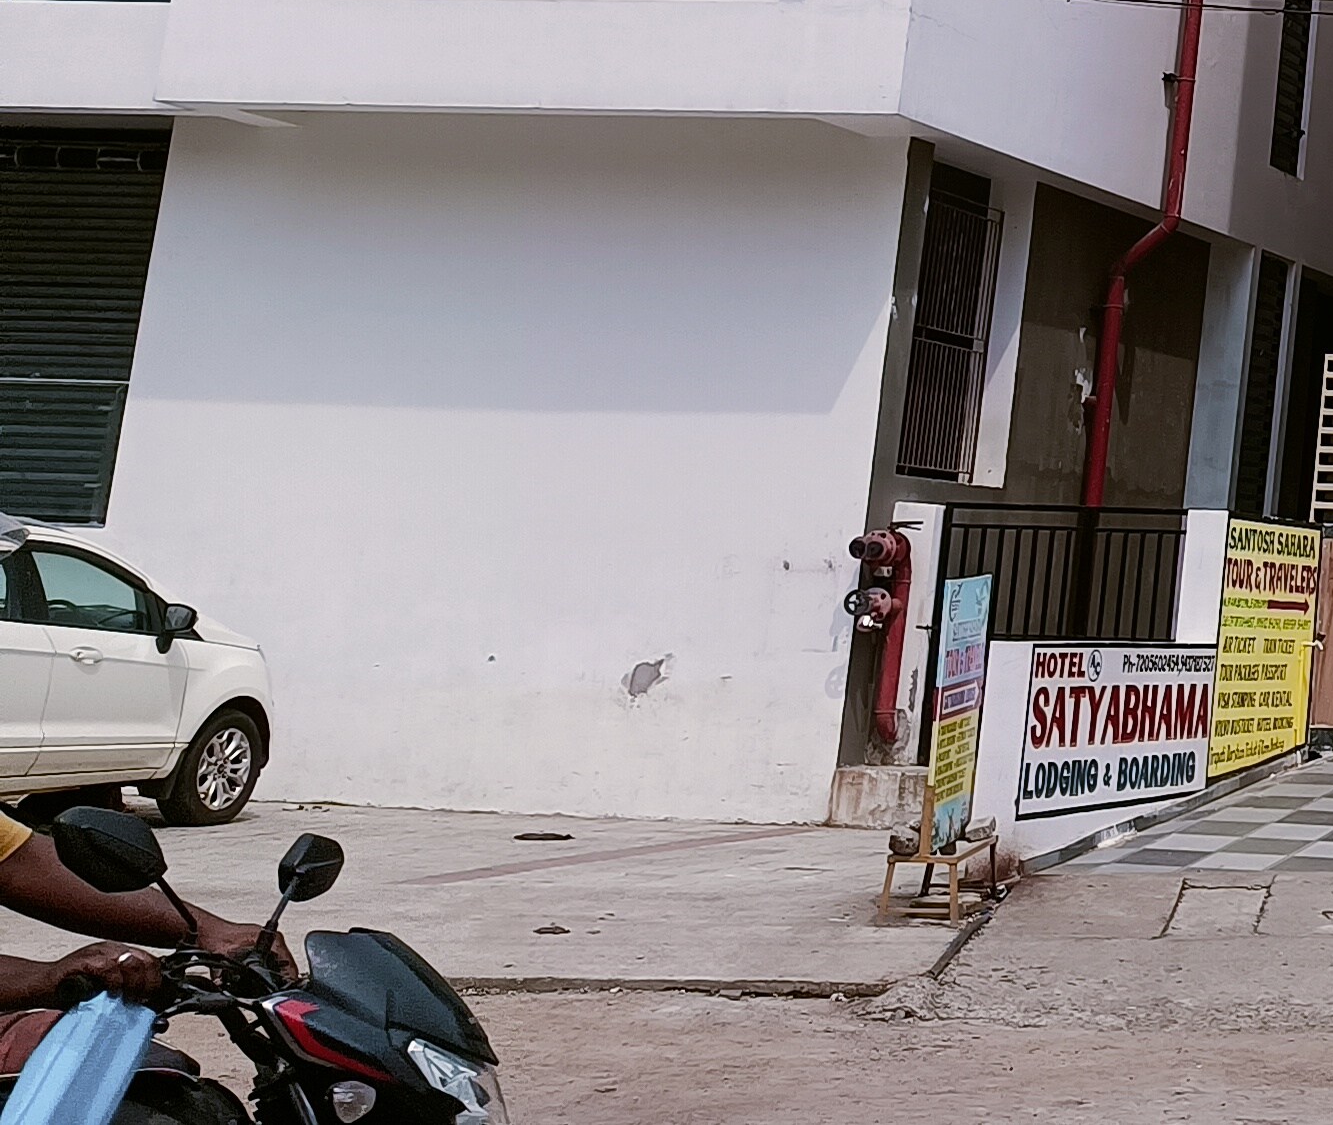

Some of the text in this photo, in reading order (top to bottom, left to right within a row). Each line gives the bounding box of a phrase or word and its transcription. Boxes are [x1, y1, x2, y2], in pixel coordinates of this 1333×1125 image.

[1229, 526, 1316, 560] SANTOSH SAHARA
[1226, 557, 1253, 593] TOUR
[1262, 561, 1317, 596] TRAVELERS
[1034, 652, 1086, 678] HOTEL
[1031, 684, 1208, 749] SATYABHAMA
[1023, 759, 1099, 800] LODGING
[1103, 763, 1112, 787] &
[1116, 751, 1196, 792] BOARDING
